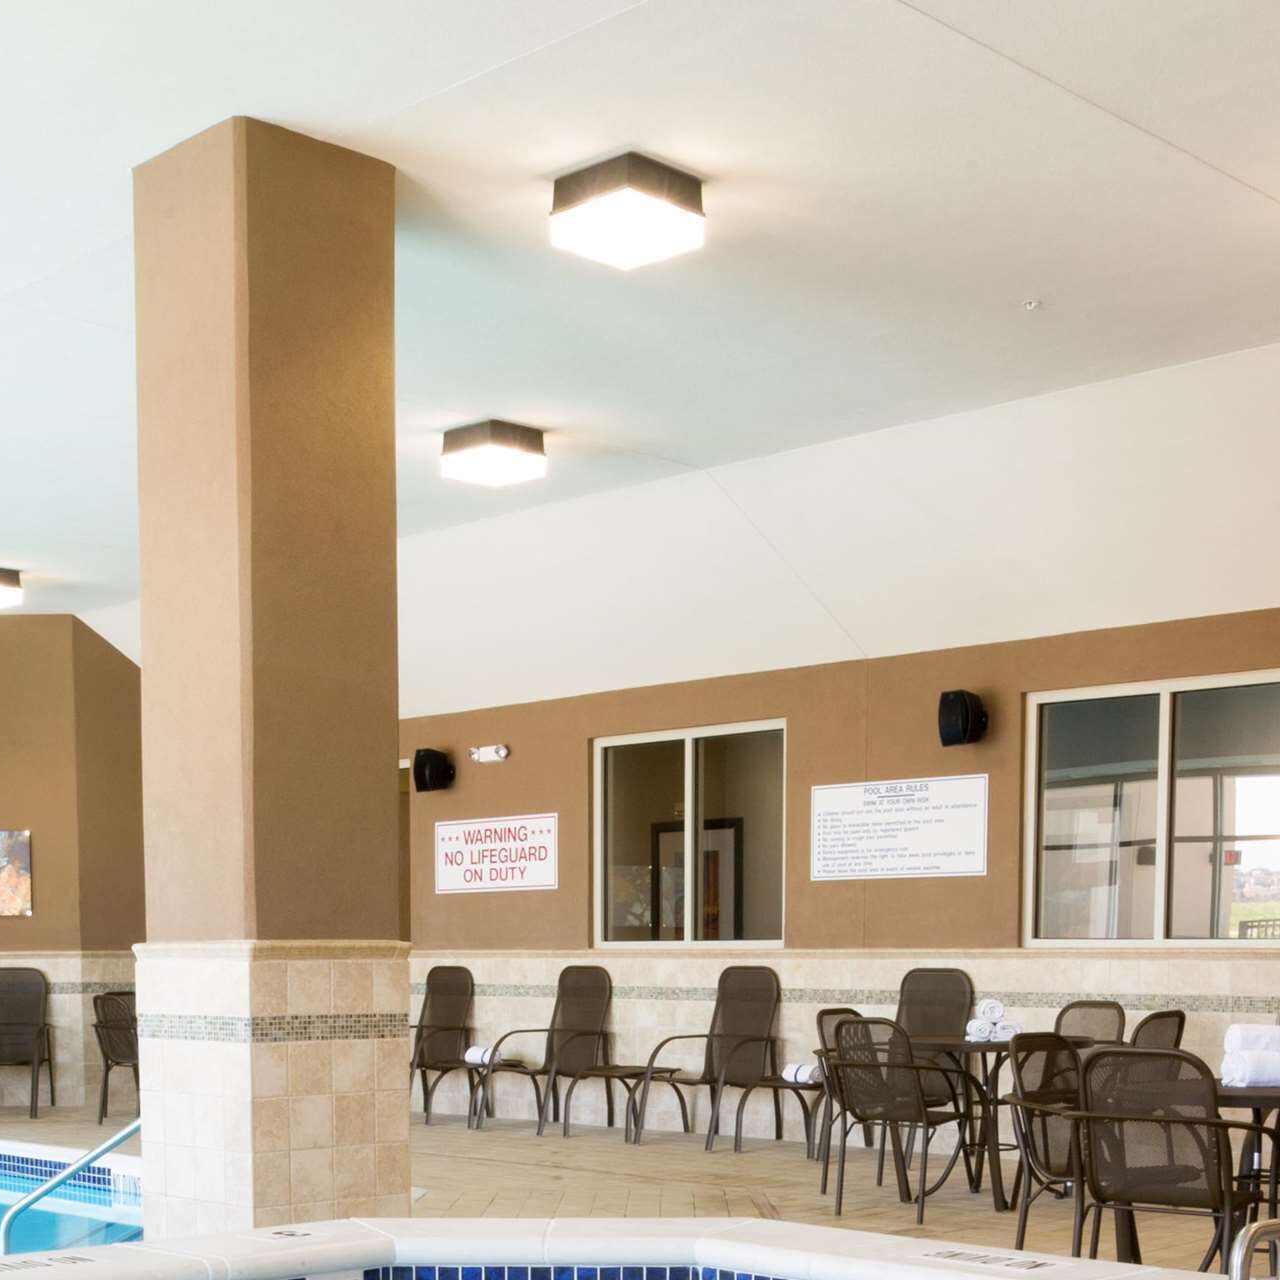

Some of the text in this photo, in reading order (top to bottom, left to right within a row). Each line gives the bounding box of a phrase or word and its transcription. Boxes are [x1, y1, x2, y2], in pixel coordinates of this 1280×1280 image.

[864, 783, 929, 795] POOL AREA RULES
[463, 826, 528, 845] WARNING
[444, 845, 548, 866] NO LIFEGUARD
[463, 865, 527, 883] ON DUTY
